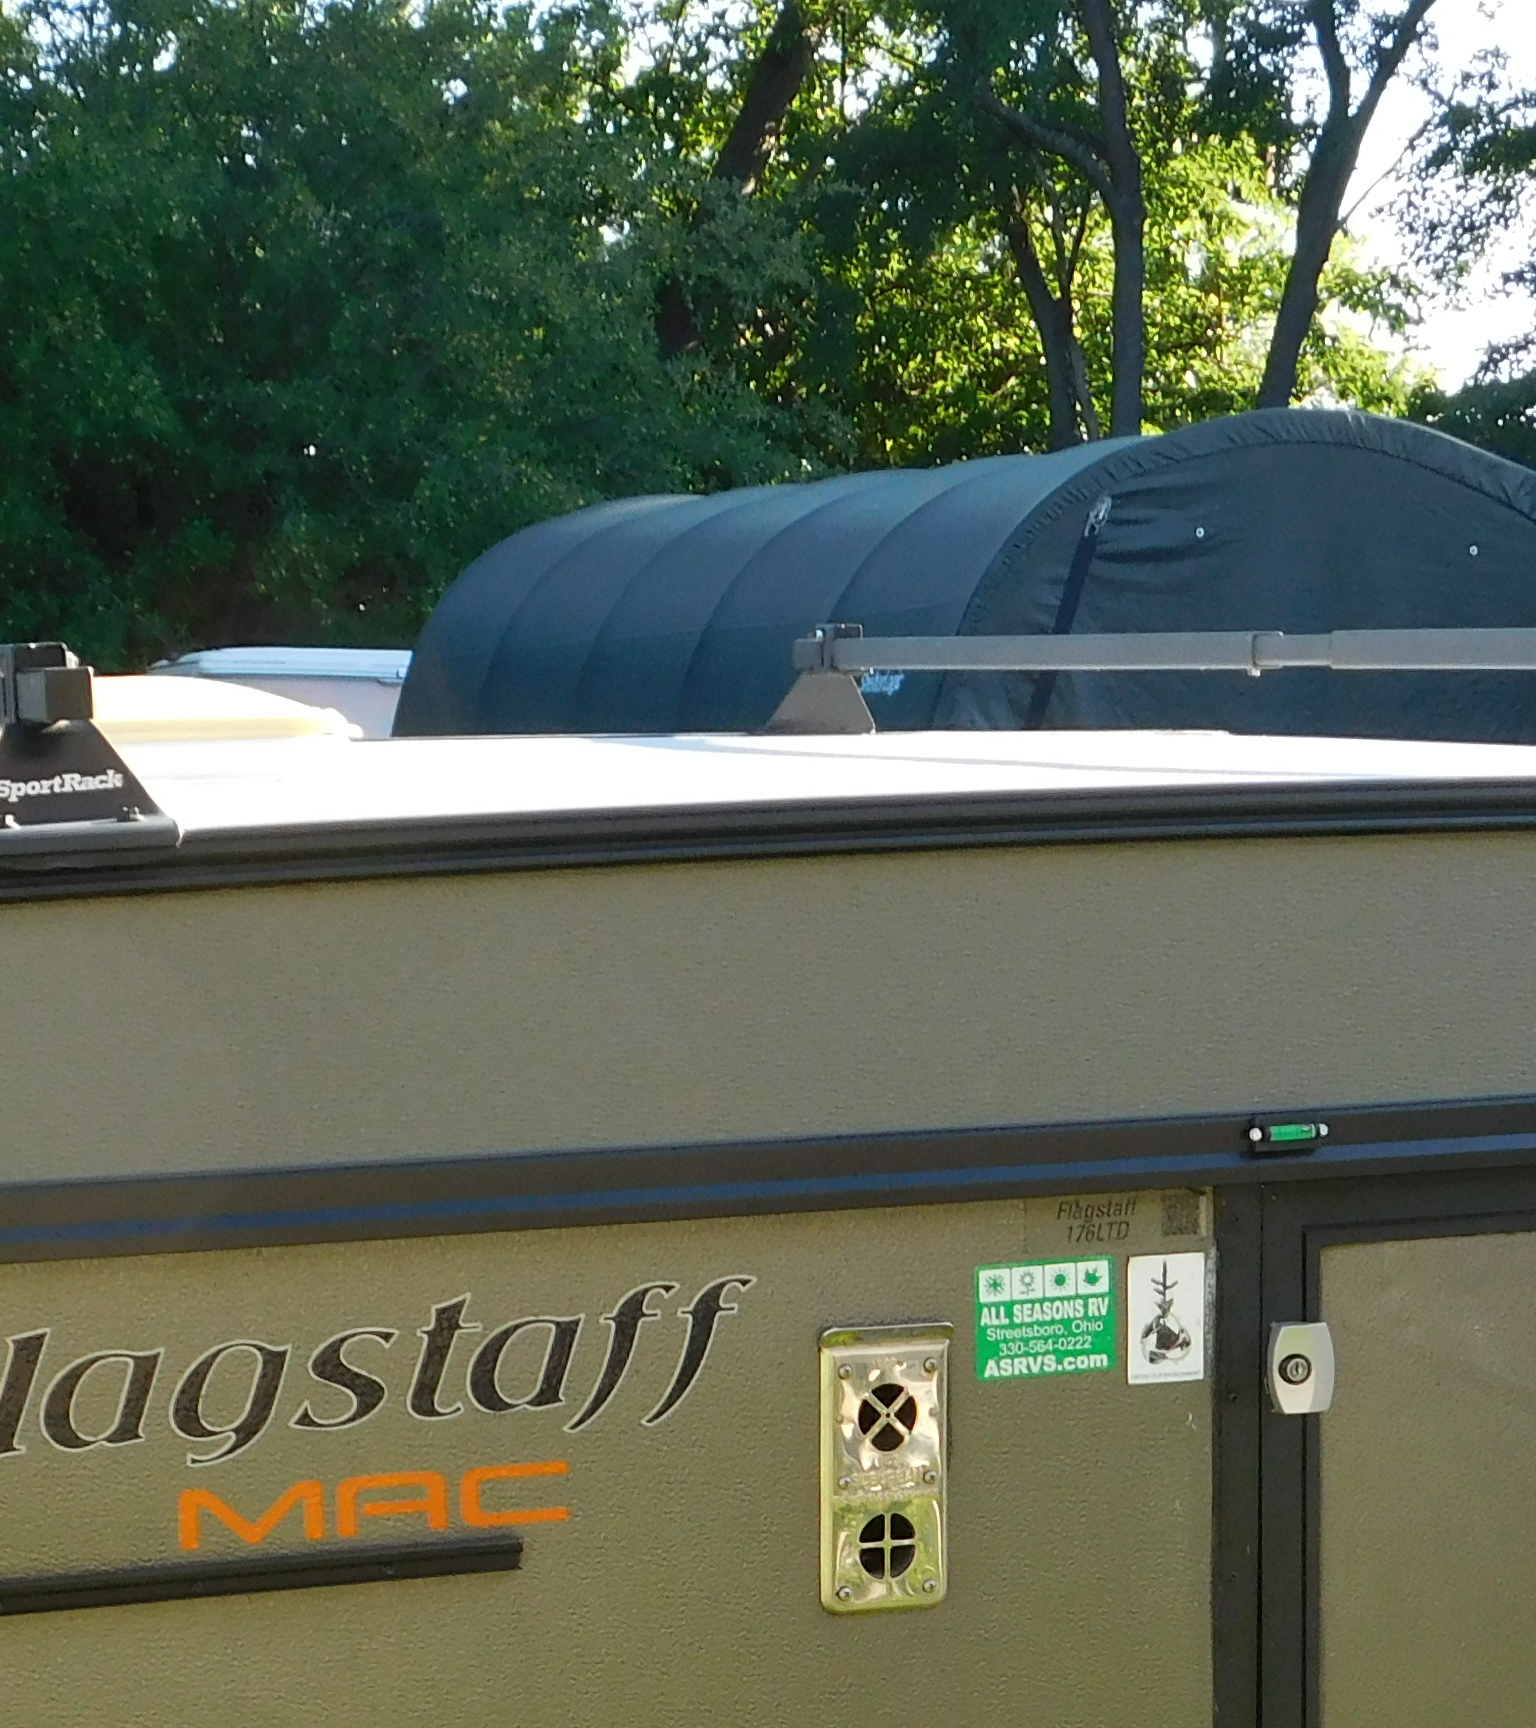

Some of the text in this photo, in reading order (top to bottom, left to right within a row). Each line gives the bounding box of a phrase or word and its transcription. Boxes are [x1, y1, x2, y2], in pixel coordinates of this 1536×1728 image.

[1066, 1221, 1130, 1244] 176LTD
[980, 1296, 1109, 1326] ALL SEASONS RV
[1071, 1319, 1104, 1333] Ohio
[999, 1336, 1092, 1356] 330-564-0222
[984, 1354, 1108, 1378] ASRVS.com
[179, 1460, 568, 1550] MAC
